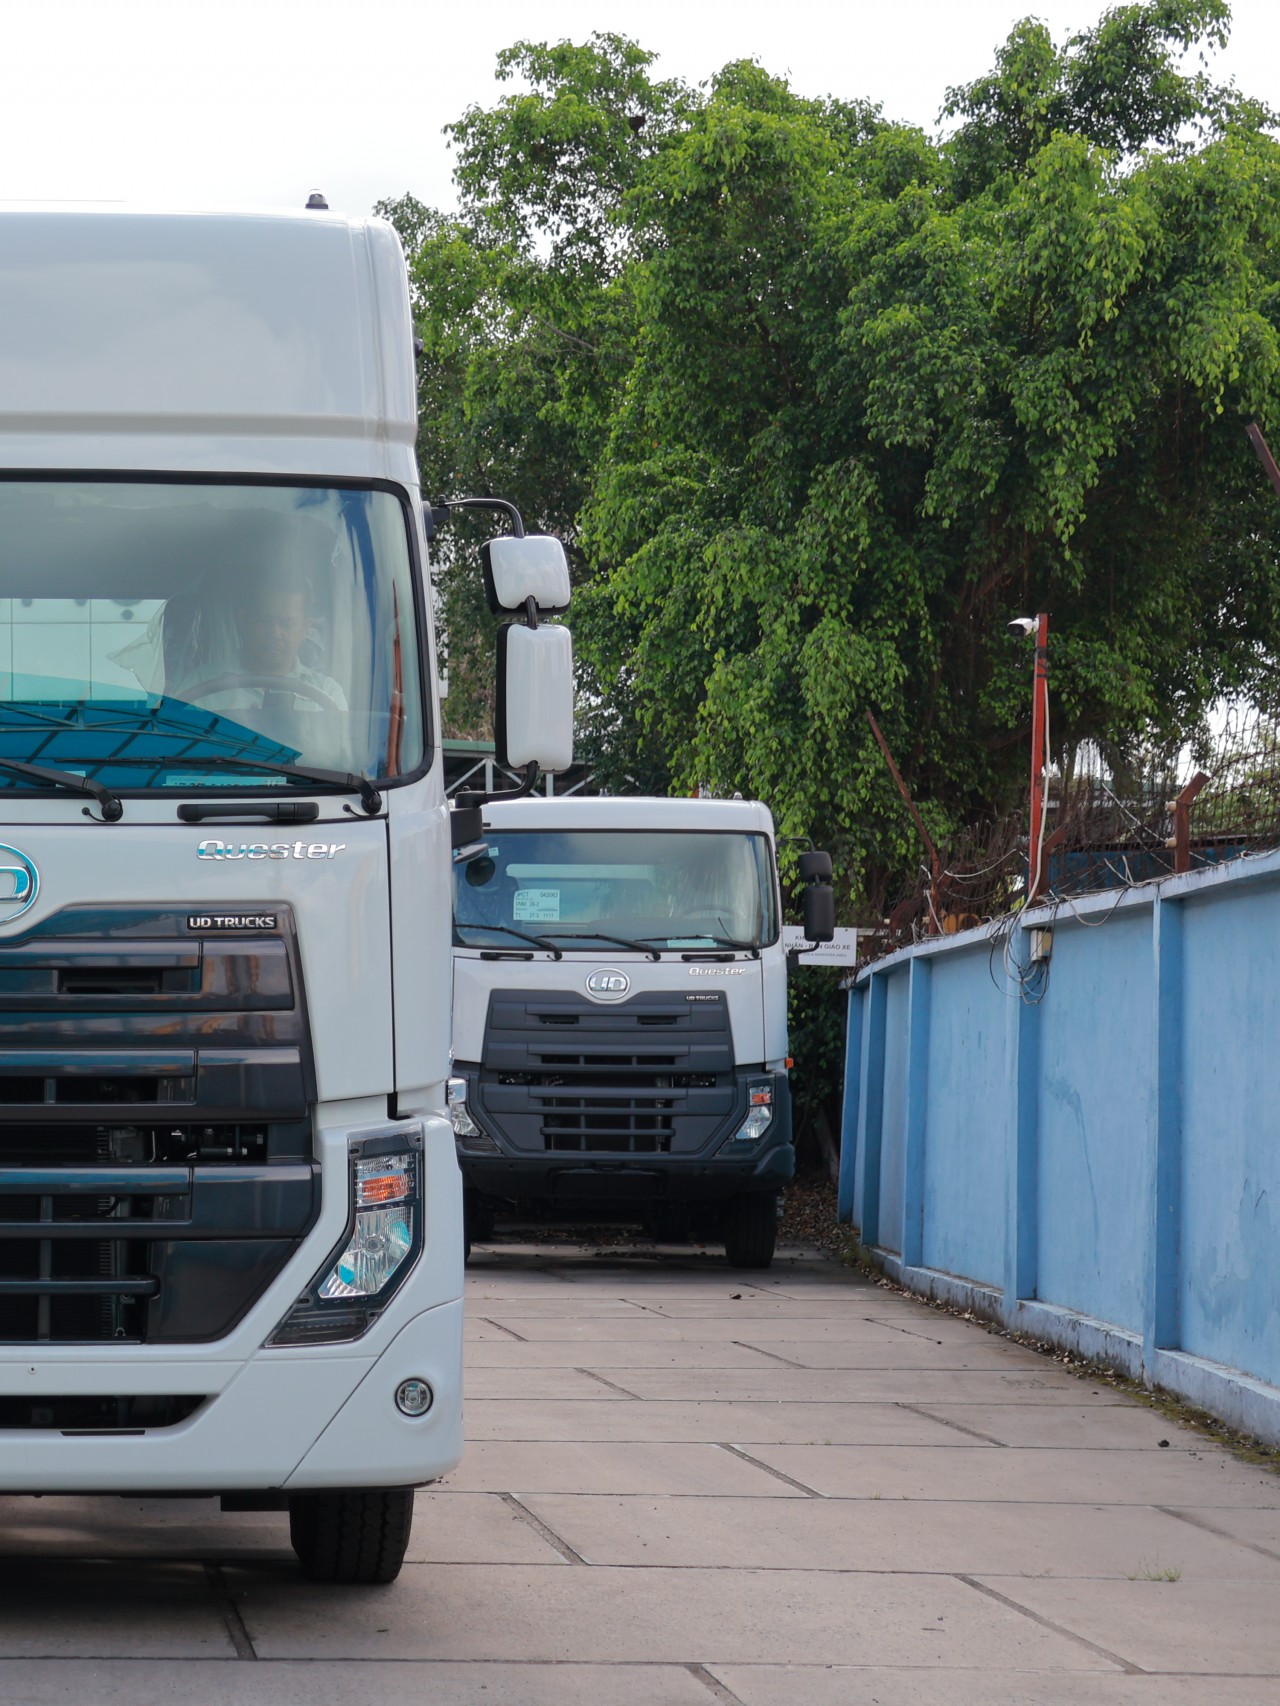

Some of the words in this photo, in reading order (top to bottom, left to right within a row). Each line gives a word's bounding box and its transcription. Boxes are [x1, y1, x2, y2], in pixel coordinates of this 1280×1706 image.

[196, 840, 346, 860] Quester
[189, 917, 211, 928] UD
[214, 916, 275, 928] TRUCKS
[688, 967, 747, 977] Quester
[589, 976, 627, 991] UD
